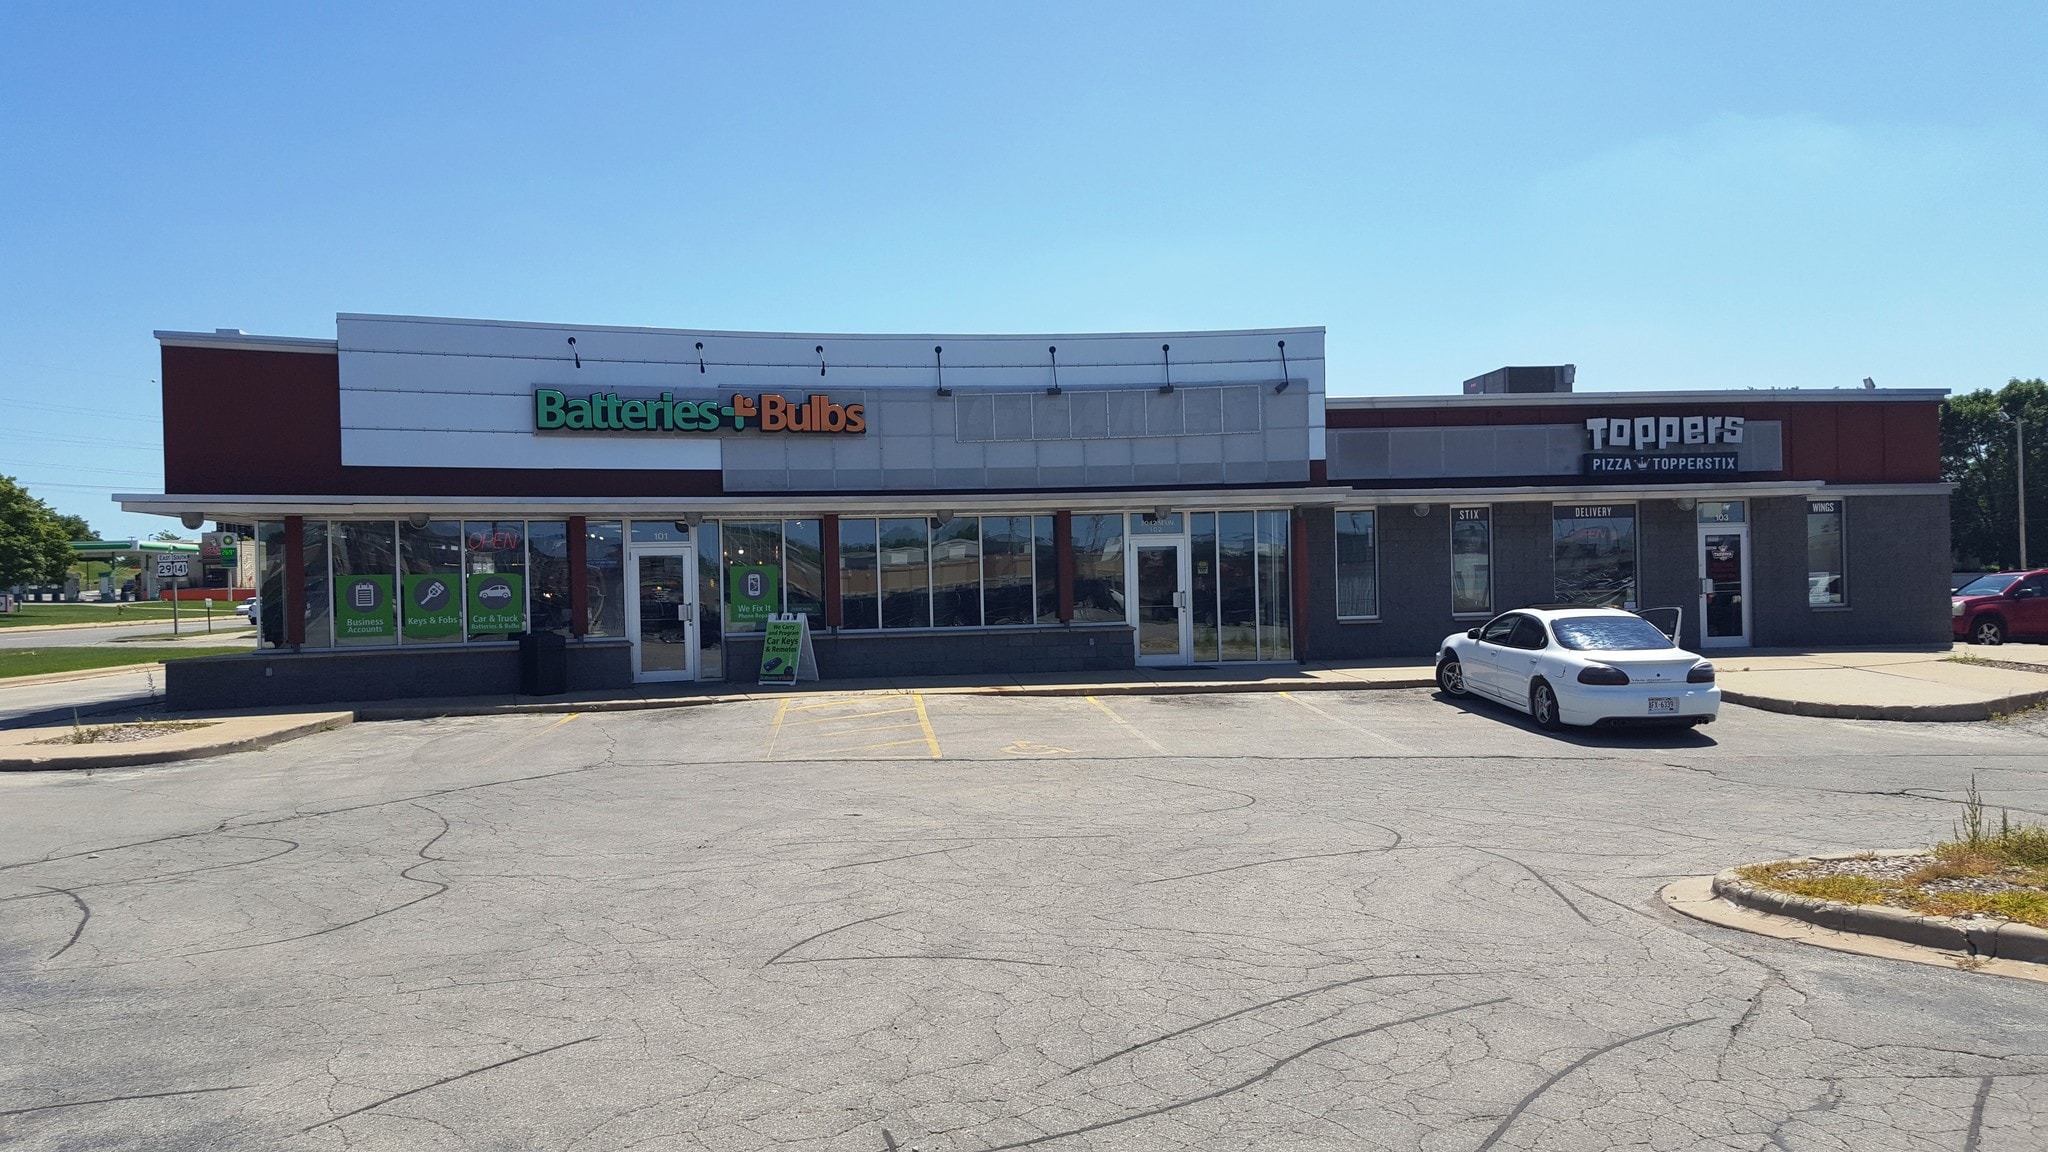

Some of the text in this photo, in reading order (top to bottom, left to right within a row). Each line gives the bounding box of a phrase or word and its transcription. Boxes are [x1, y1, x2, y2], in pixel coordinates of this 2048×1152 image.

[535, 389, 720, 432] Batteries
[760, 393, 867, 433] Bulbs
[1593, 457, 1735, 471] PIZZA TOPPERSTIX
[1575, 507, 1612, 517] DELIVERY
[1812, 502, 1835, 513] WINGS
[1459, 509, 1480, 520] STIX
[1715, 513, 1729, 521] 103
[468, 531, 519, 550] OPEN
[654, 532, 668, 540] 101
[159, 564, 187, 574] 29 141
[737, 604, 771, 612] We Fix It
[346, 618, 384, 626] Business
[408, 617, 427, 627] Keys
[438, 616, 458, 624] Fobs
[472, 615, 487, 623] Car
[497, 614, 518, 622] Truck
[766, 637, 799, 646] Car Keys
